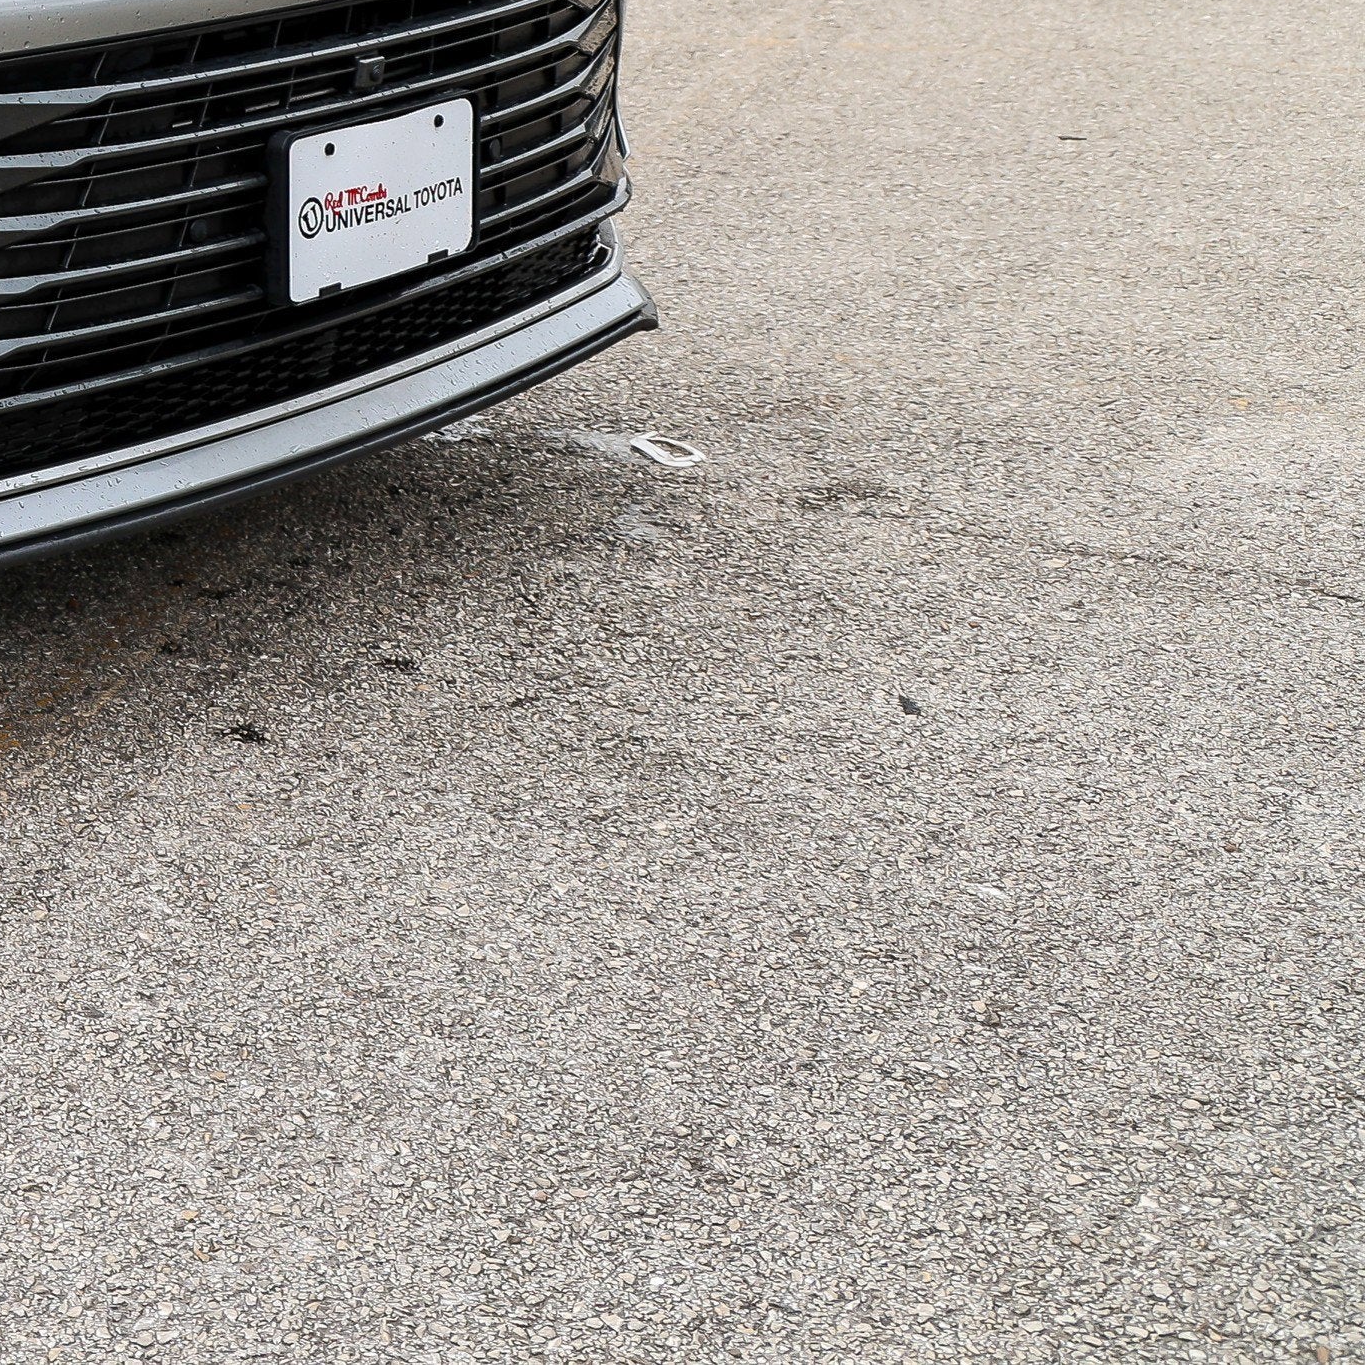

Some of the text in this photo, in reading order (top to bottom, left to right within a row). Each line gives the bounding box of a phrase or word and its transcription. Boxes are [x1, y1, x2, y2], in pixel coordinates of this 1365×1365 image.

[324, 192, 344, 215] Red
[325, 195, 412, 233] UNIVERSAL
[414, 177, 463, 209] TOYOTA
